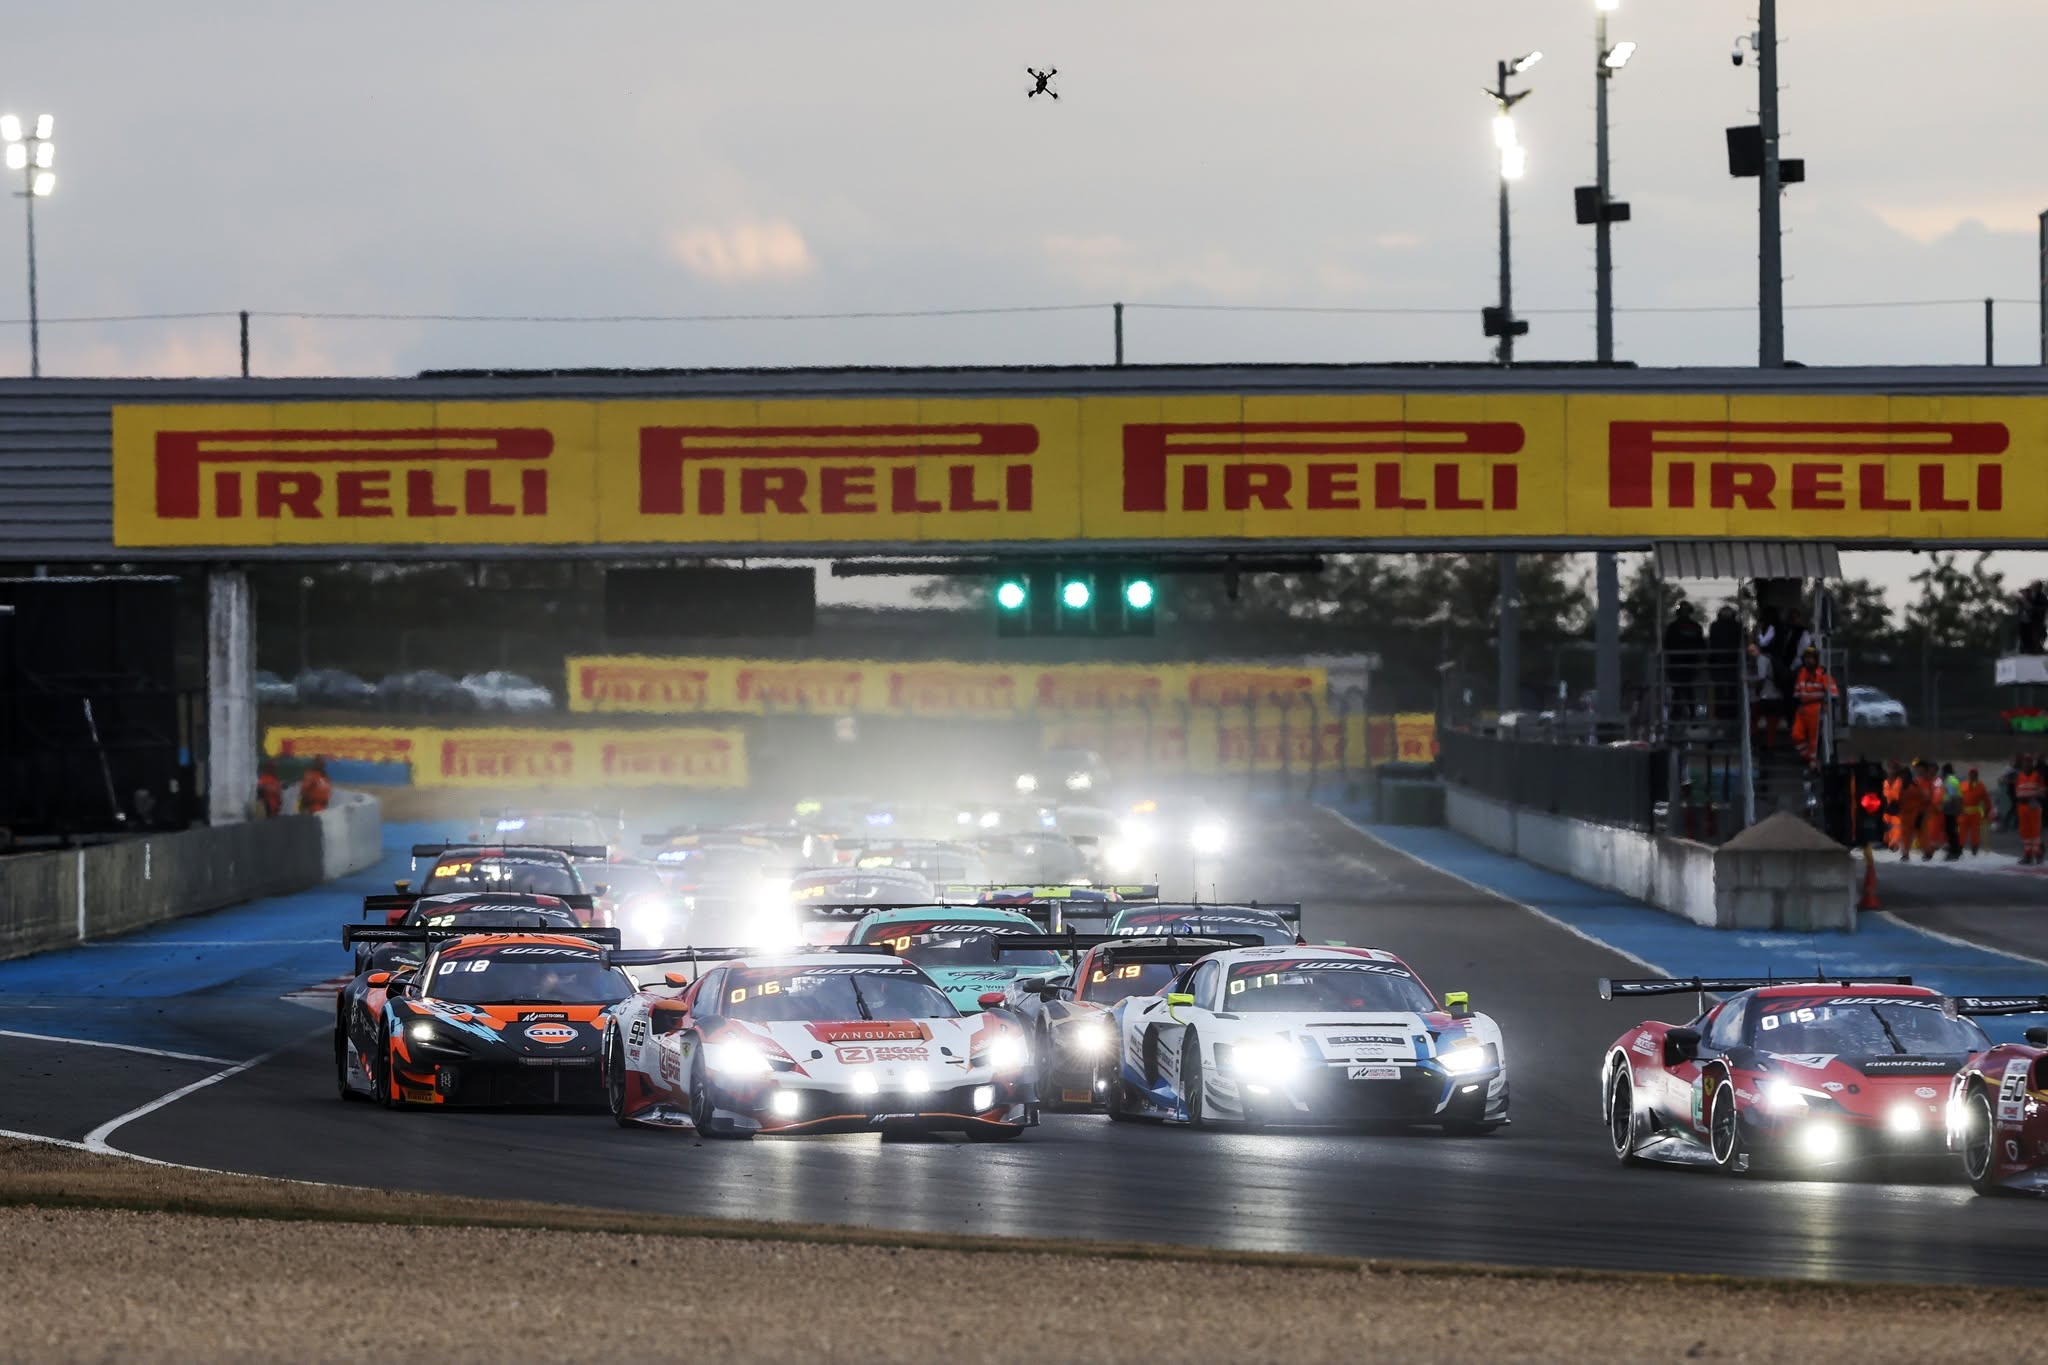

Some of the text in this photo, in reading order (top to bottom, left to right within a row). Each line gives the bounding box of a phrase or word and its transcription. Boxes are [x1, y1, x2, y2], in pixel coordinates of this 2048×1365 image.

[156, 428, 554, 518] PIRELLI
[640, 425, 1038, 515] PIRELLI
[1123, 423, 1525, 512] PIRELLI
[1609, 421, 2009, 509] PIRELLI
[470, 904, 569, 918] WORLD
[1180, 915, 1278, 927] WORLD
[438, 960, 491, 975] 018
[1296, 962, 1411, 977] WORLD
[730, 980, 781, 1004] 016
[1230, 973, 1279, 995] 017
[629, 1020, 646, 1046] 93
[828, 1031, 915, 1039] VANGUART
[2001, 1075, 2026, 1102] 50
